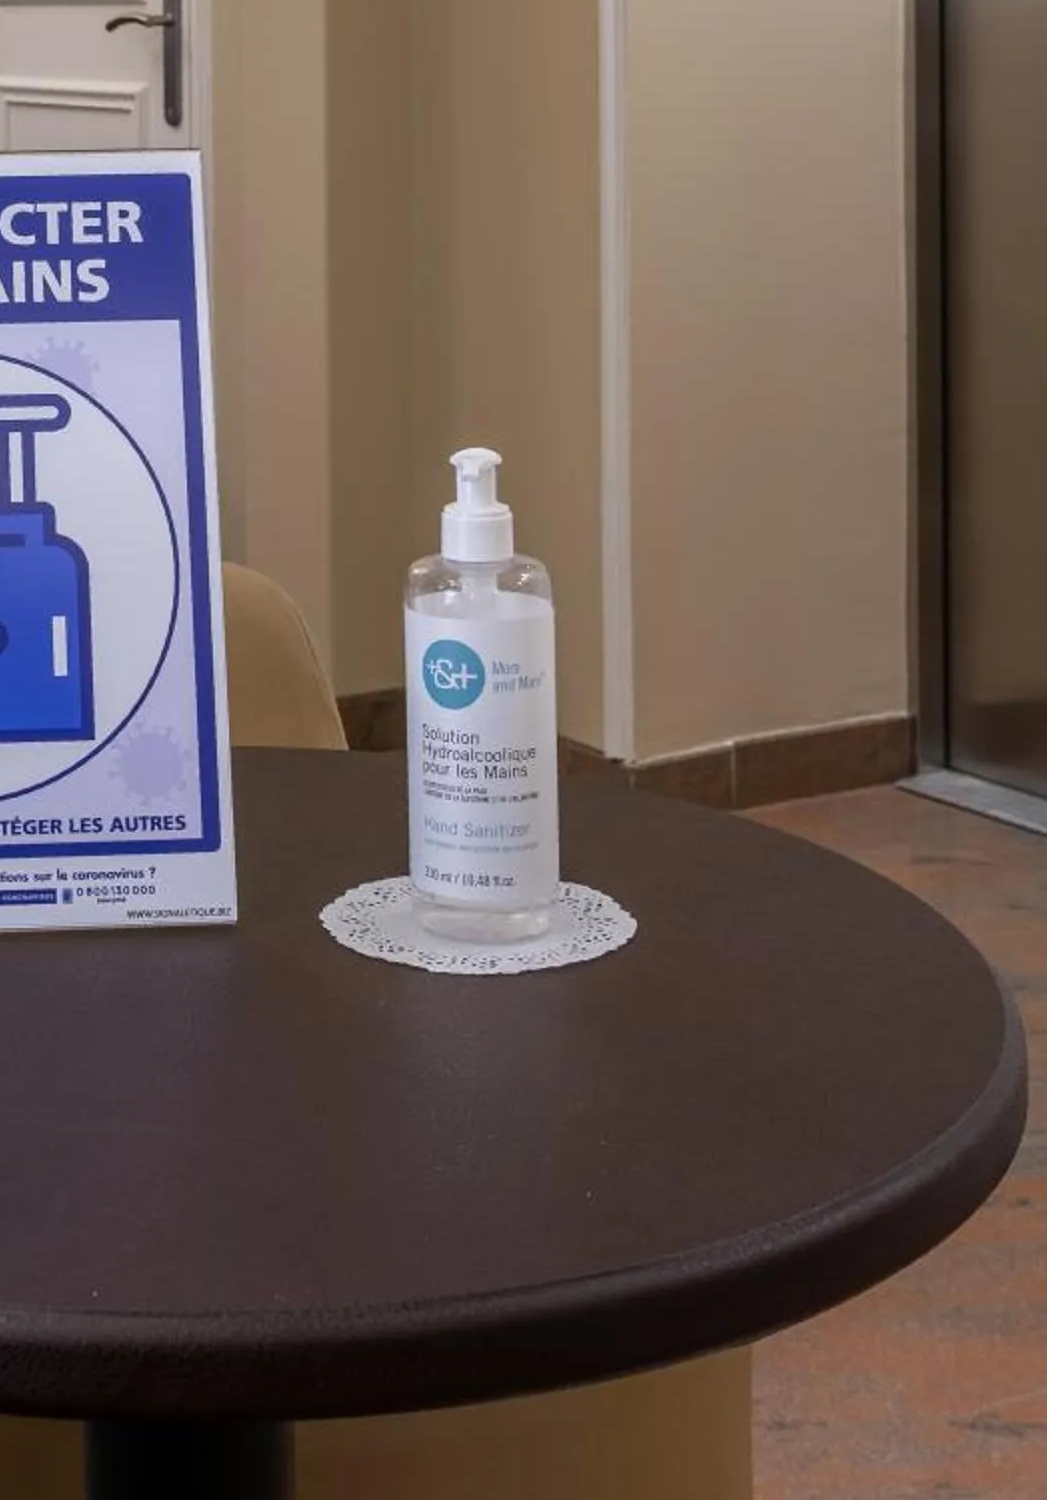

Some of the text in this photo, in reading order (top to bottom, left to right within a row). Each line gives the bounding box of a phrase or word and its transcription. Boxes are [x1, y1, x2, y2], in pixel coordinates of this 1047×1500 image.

[422, 723, 480, 745] Solution
[422, 740, 537, 765] Hydroalcoolique
[422, 761, 528, 779] pour les Mains
[69, 817, 103, 833] LES
[109, 814, 186, 833] AUTRES
[424, 814, 531, 839] Hand Sanitizer
[33, 873, 53, 882] sur
[56, 868, 68, 881] le
[72, 867, 145, 881] coronavirus
[148, 866, 156, 879] ?
